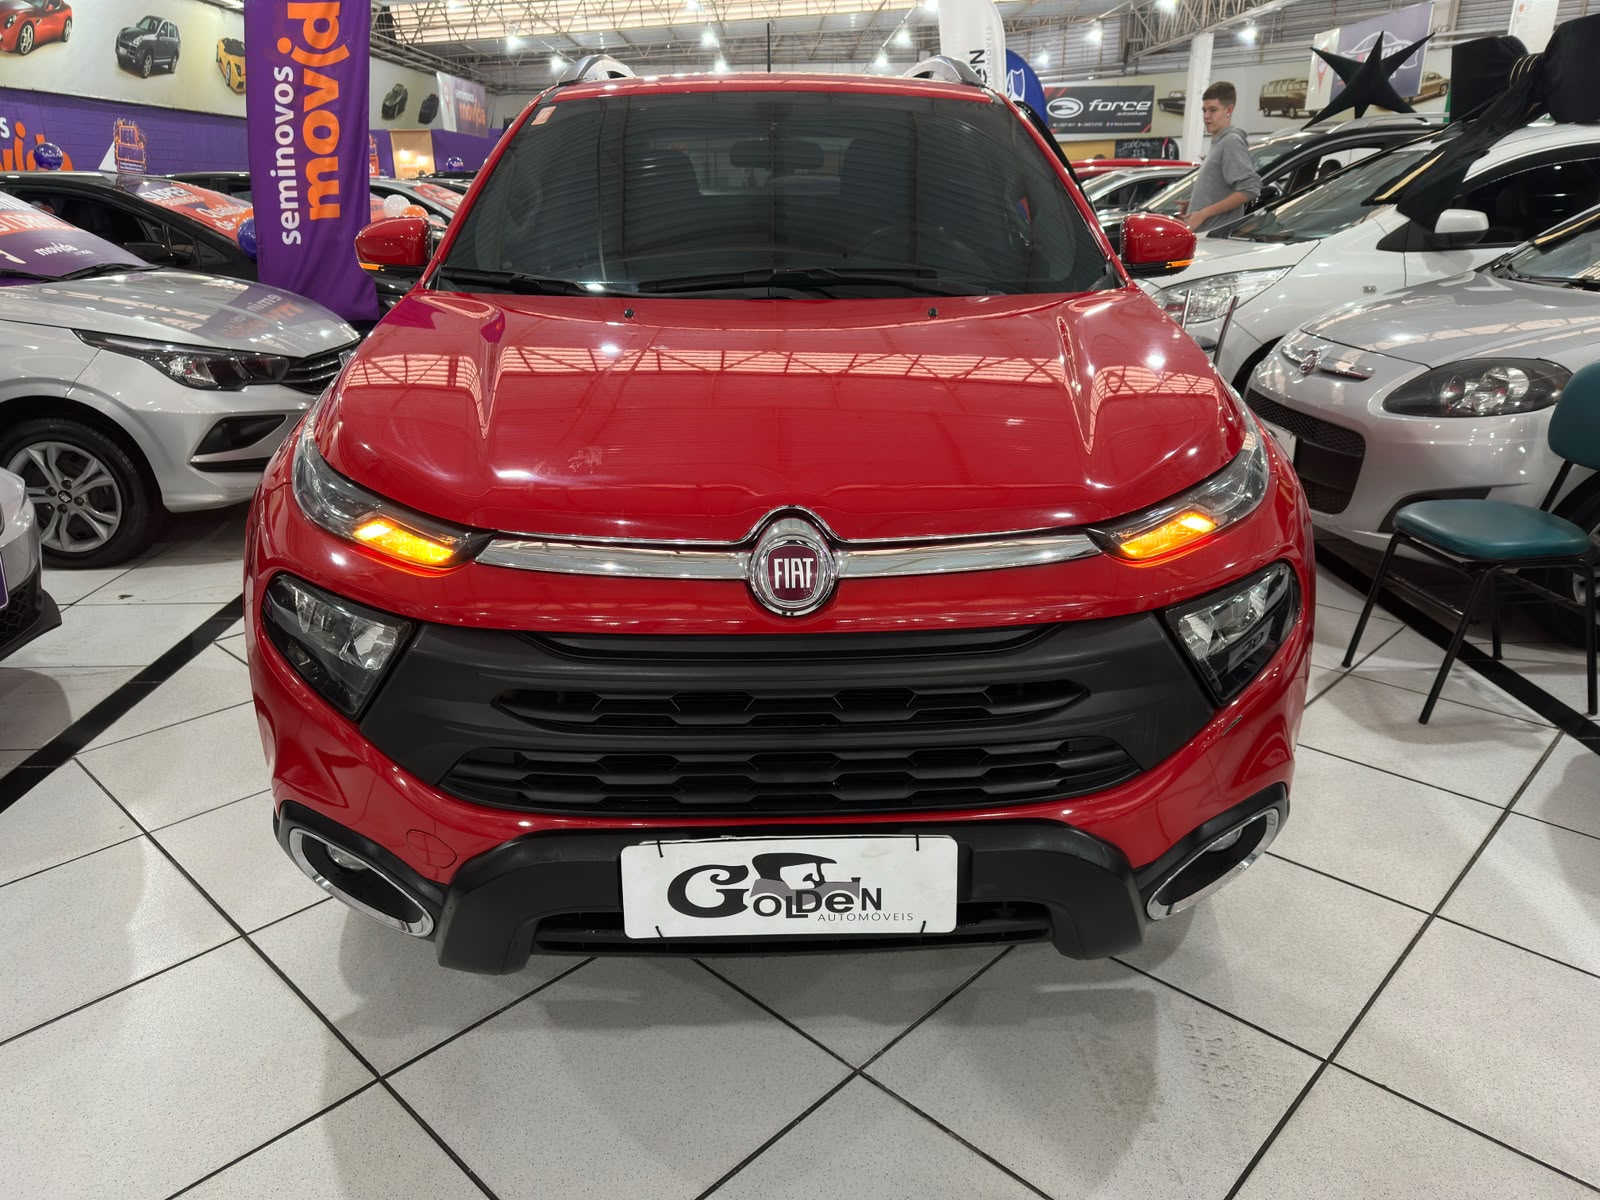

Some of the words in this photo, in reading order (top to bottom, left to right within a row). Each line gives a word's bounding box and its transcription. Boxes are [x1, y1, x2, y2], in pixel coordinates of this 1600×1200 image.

[1088, 99, 1152, 112] force
[270, 65, 301, 246] seminovos
[773, 557, 814, 589] FIAT
